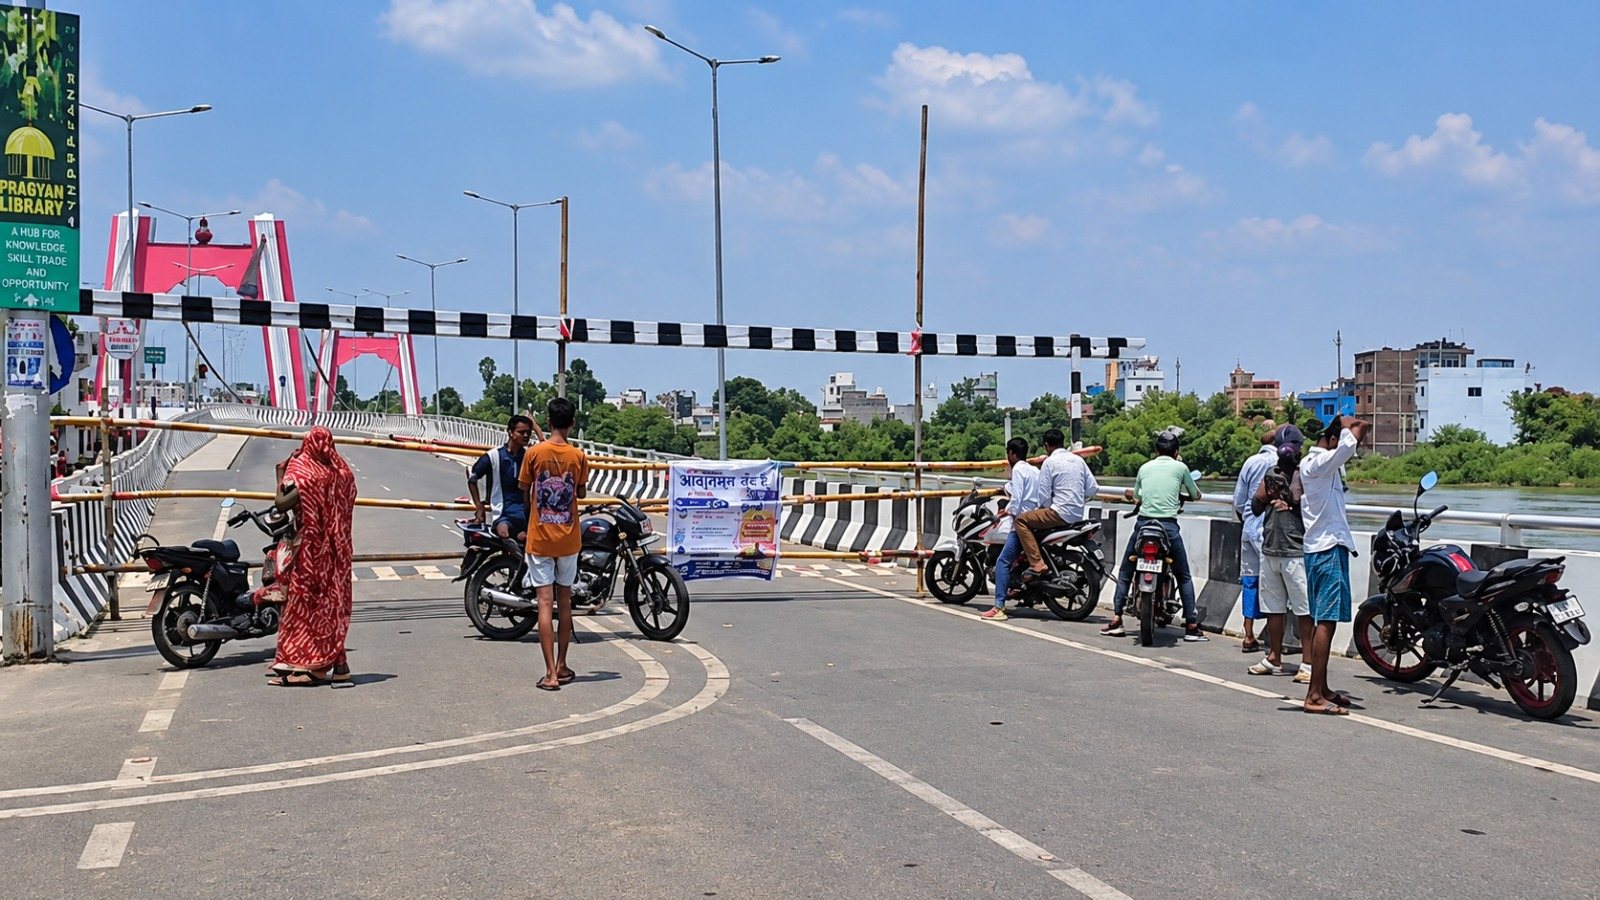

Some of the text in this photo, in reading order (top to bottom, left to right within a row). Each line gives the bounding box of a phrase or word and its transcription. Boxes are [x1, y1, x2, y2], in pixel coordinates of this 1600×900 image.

[0, 180, 63, 199] PRAGYAN
[0, 196, 63, 215] LIBRARY
[11, 227, 60, 239] A HUB FOR
[7, 253, 67, 266] SKILL TRADE
[26, 267, 47, 277] AND
[2, 278, 69, 292] OPPORTUNITY
